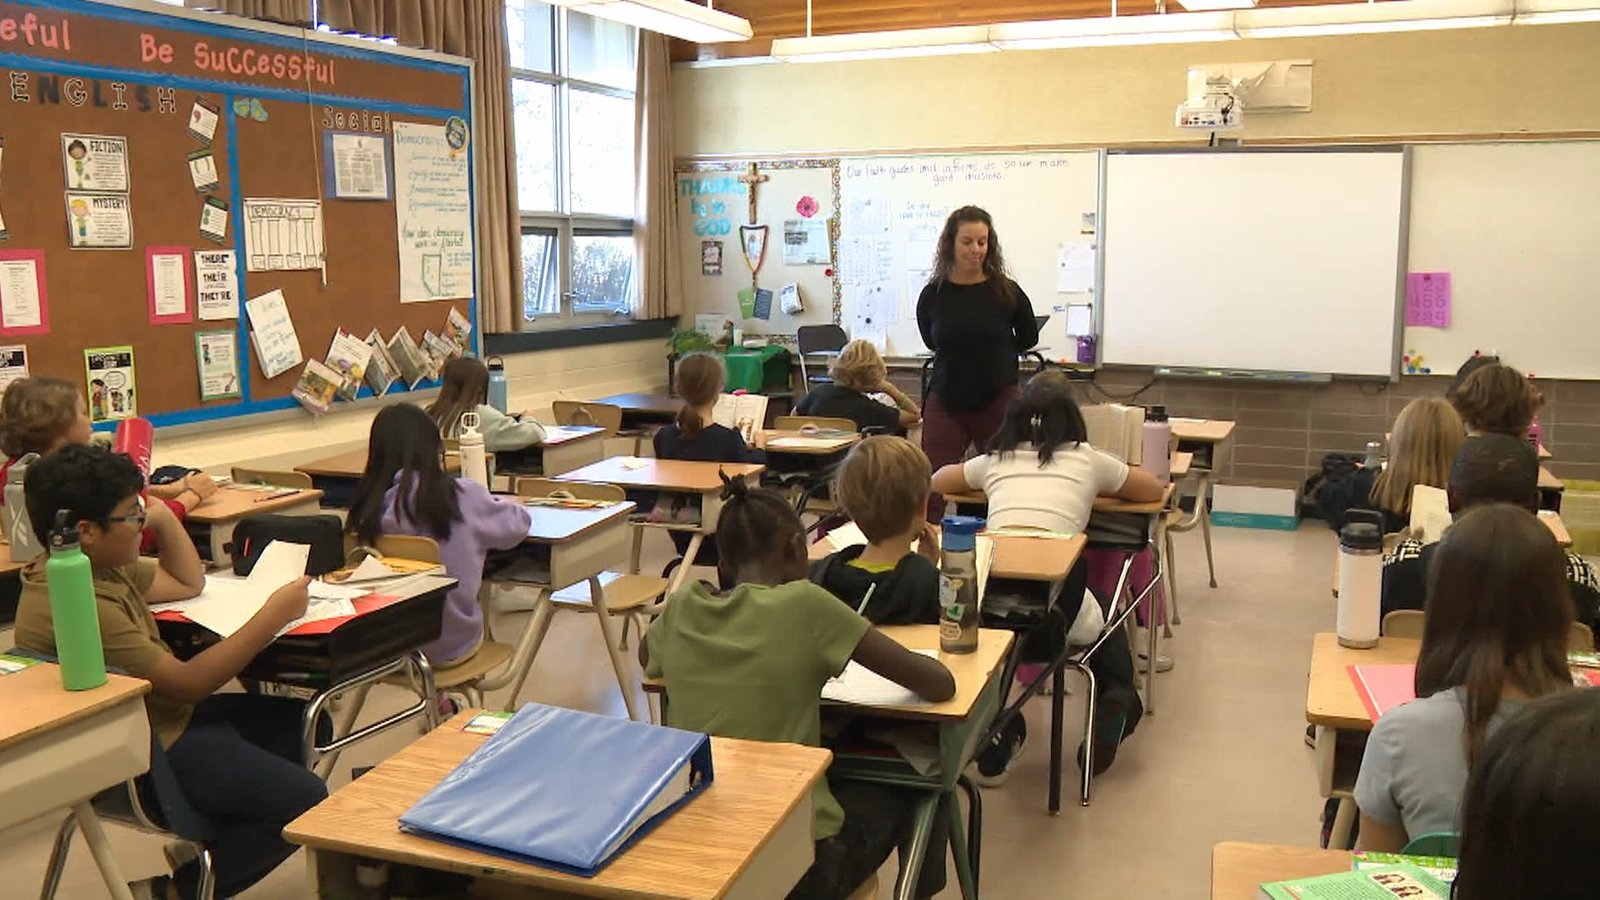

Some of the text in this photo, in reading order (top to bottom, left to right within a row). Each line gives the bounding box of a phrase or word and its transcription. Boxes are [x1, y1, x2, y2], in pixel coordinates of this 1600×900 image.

[140, 33, 174, 64] Be
[9, 70, 176, 113] ENGLISH
[89, 140, 123, 153] FICTION
[92, 197, 127, 209] MYSTERY
[694, 217, 731, 236] GOD
